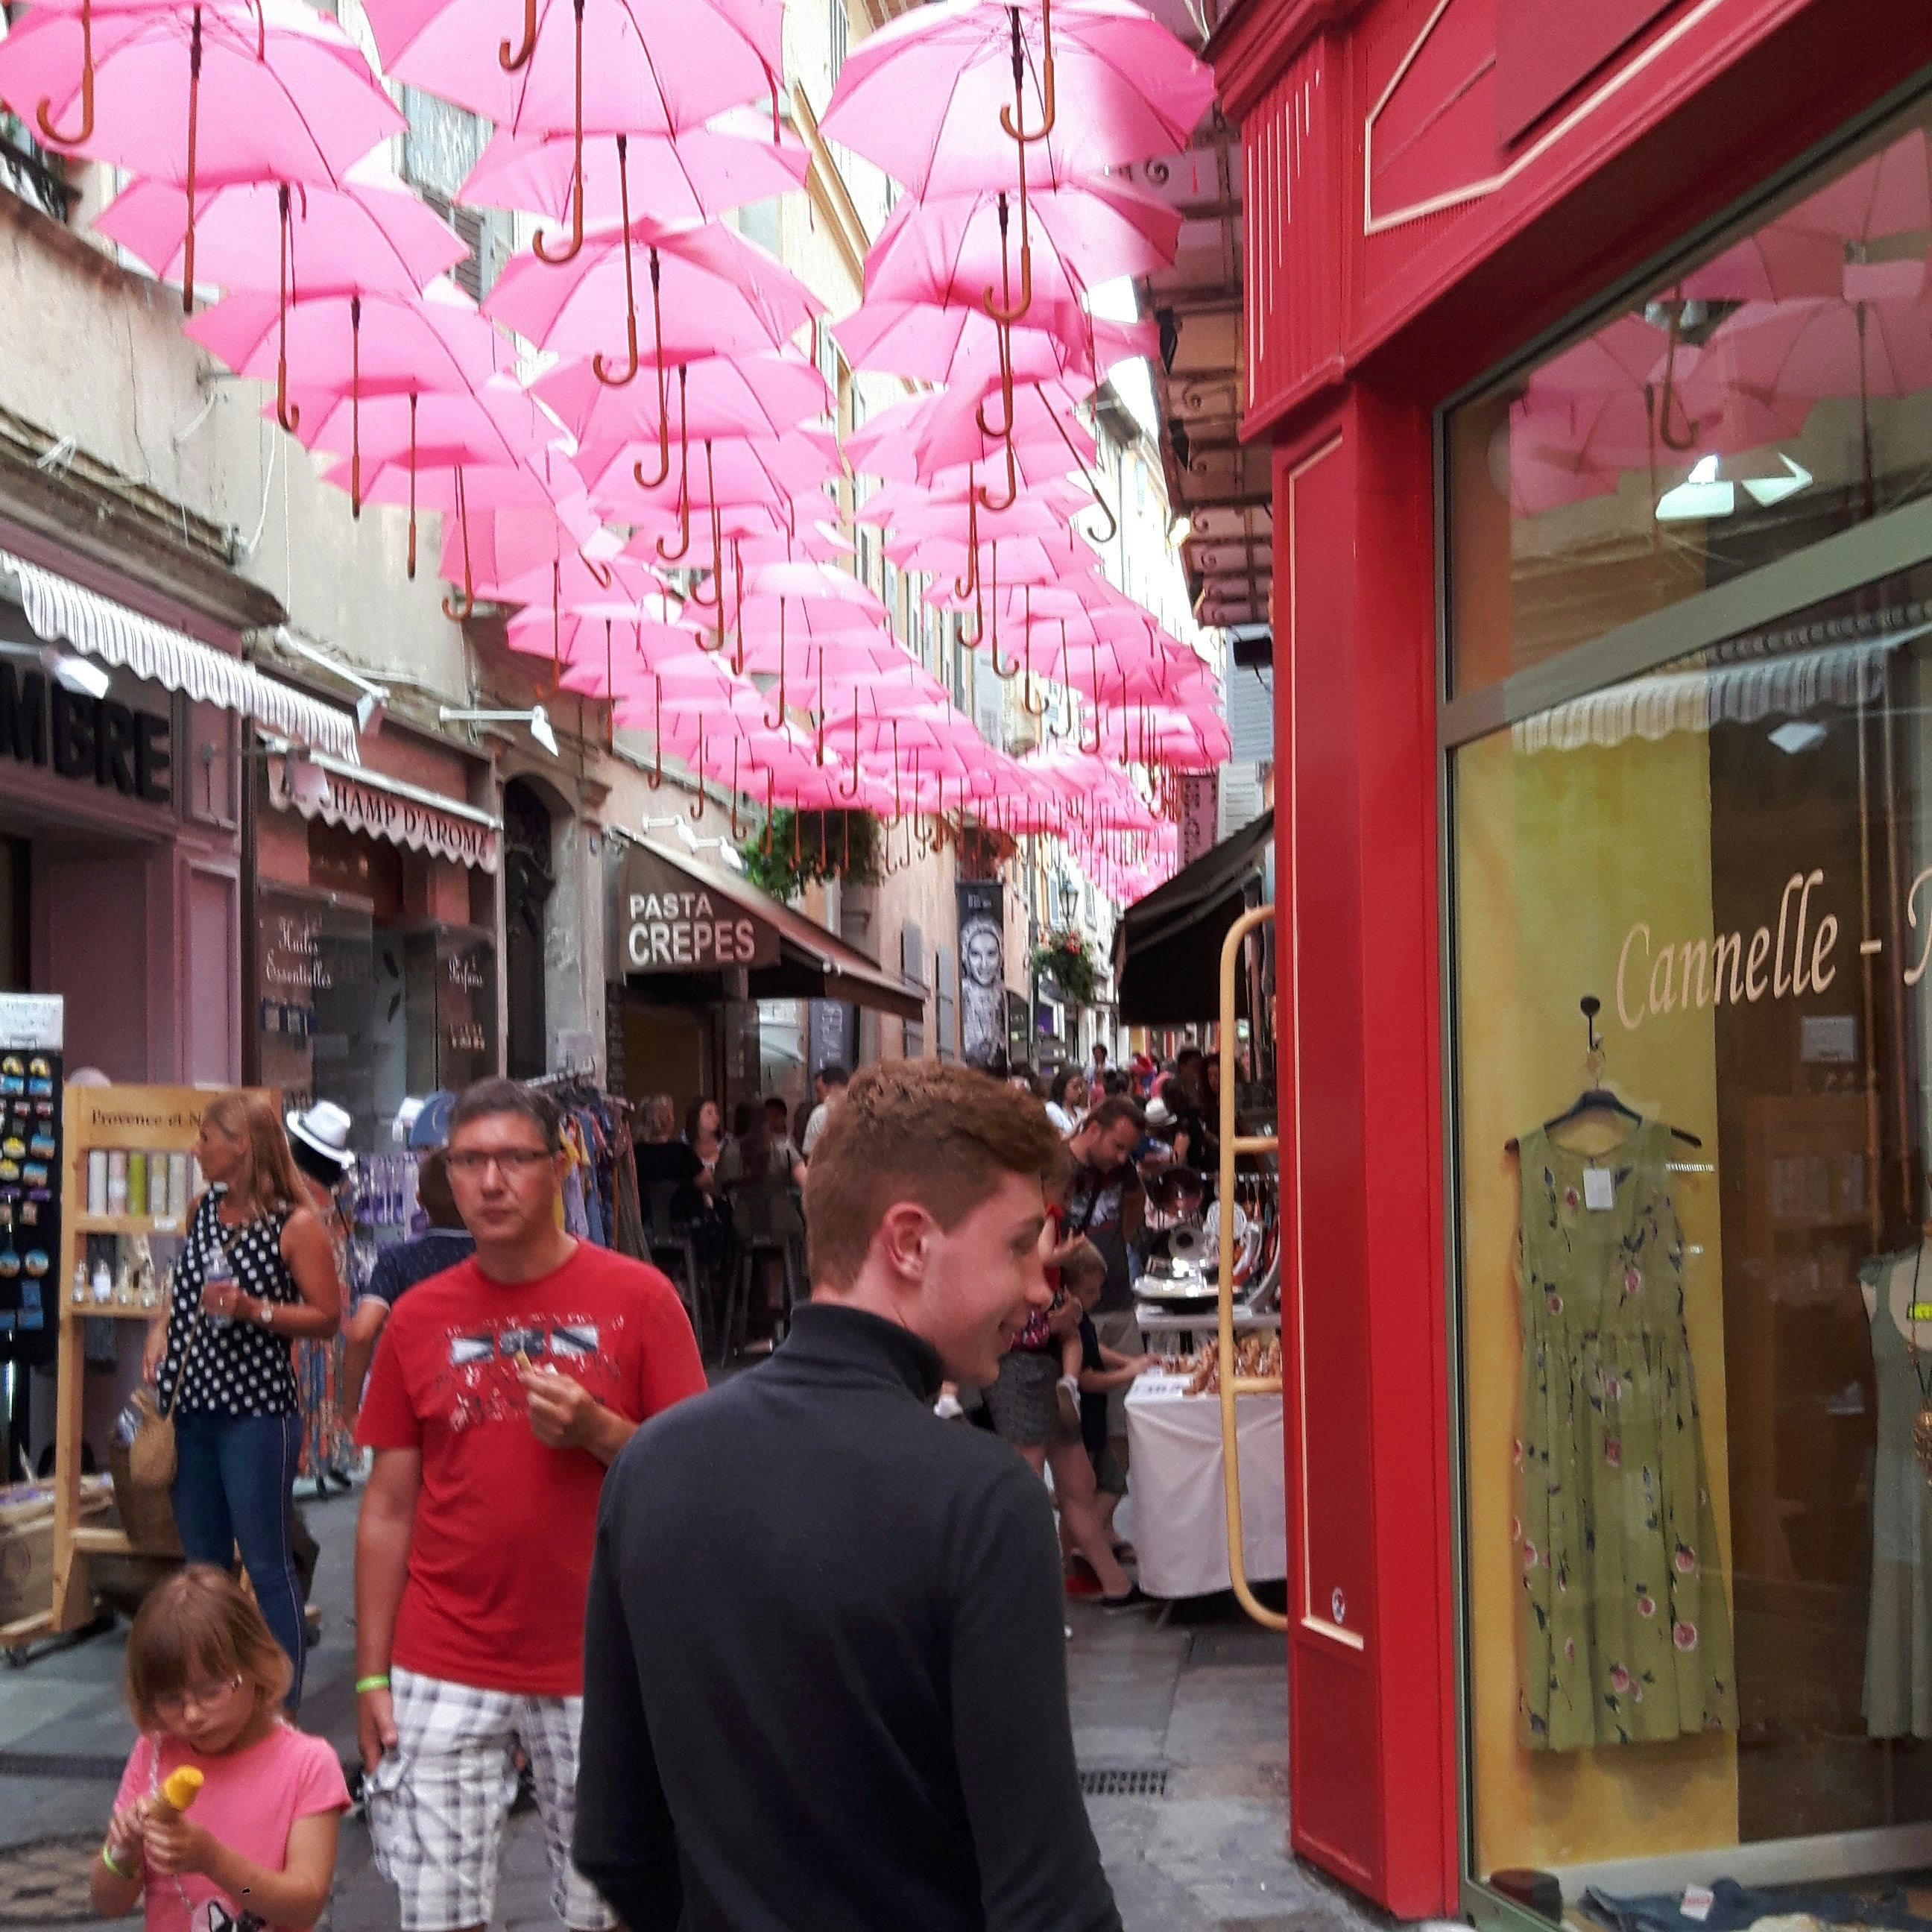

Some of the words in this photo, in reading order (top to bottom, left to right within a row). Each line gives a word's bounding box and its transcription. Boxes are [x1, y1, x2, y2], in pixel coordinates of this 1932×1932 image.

[629, 893, 714, 921] PASTA
[628, 918, 755, 967] CREPES
[1616, 868, 1838, 1031] Cannelle
